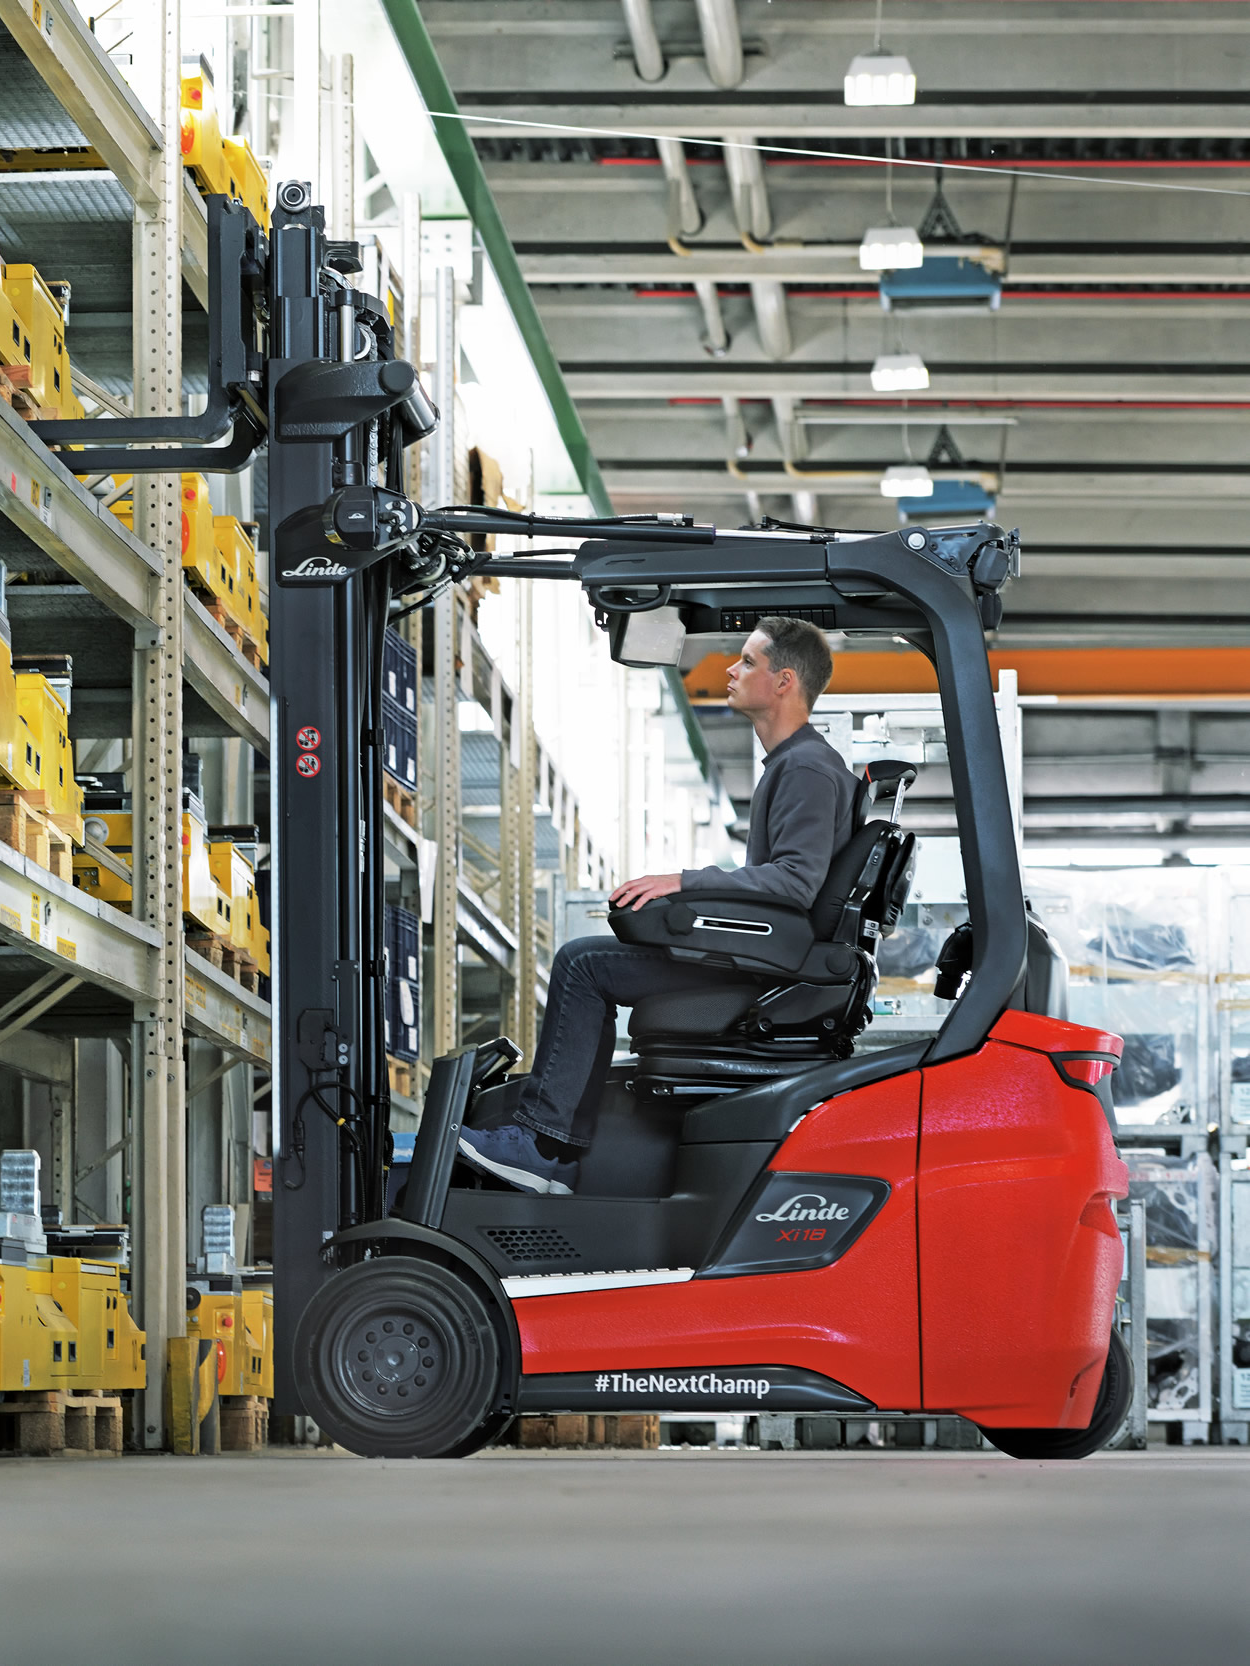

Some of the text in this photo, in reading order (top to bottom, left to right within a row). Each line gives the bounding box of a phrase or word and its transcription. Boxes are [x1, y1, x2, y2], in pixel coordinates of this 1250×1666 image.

[282, 556, 347, 577] Linde
[755, 1193, 850, 1222] Linde
[595, 1372, 770, 1399] #TheNextChamp
